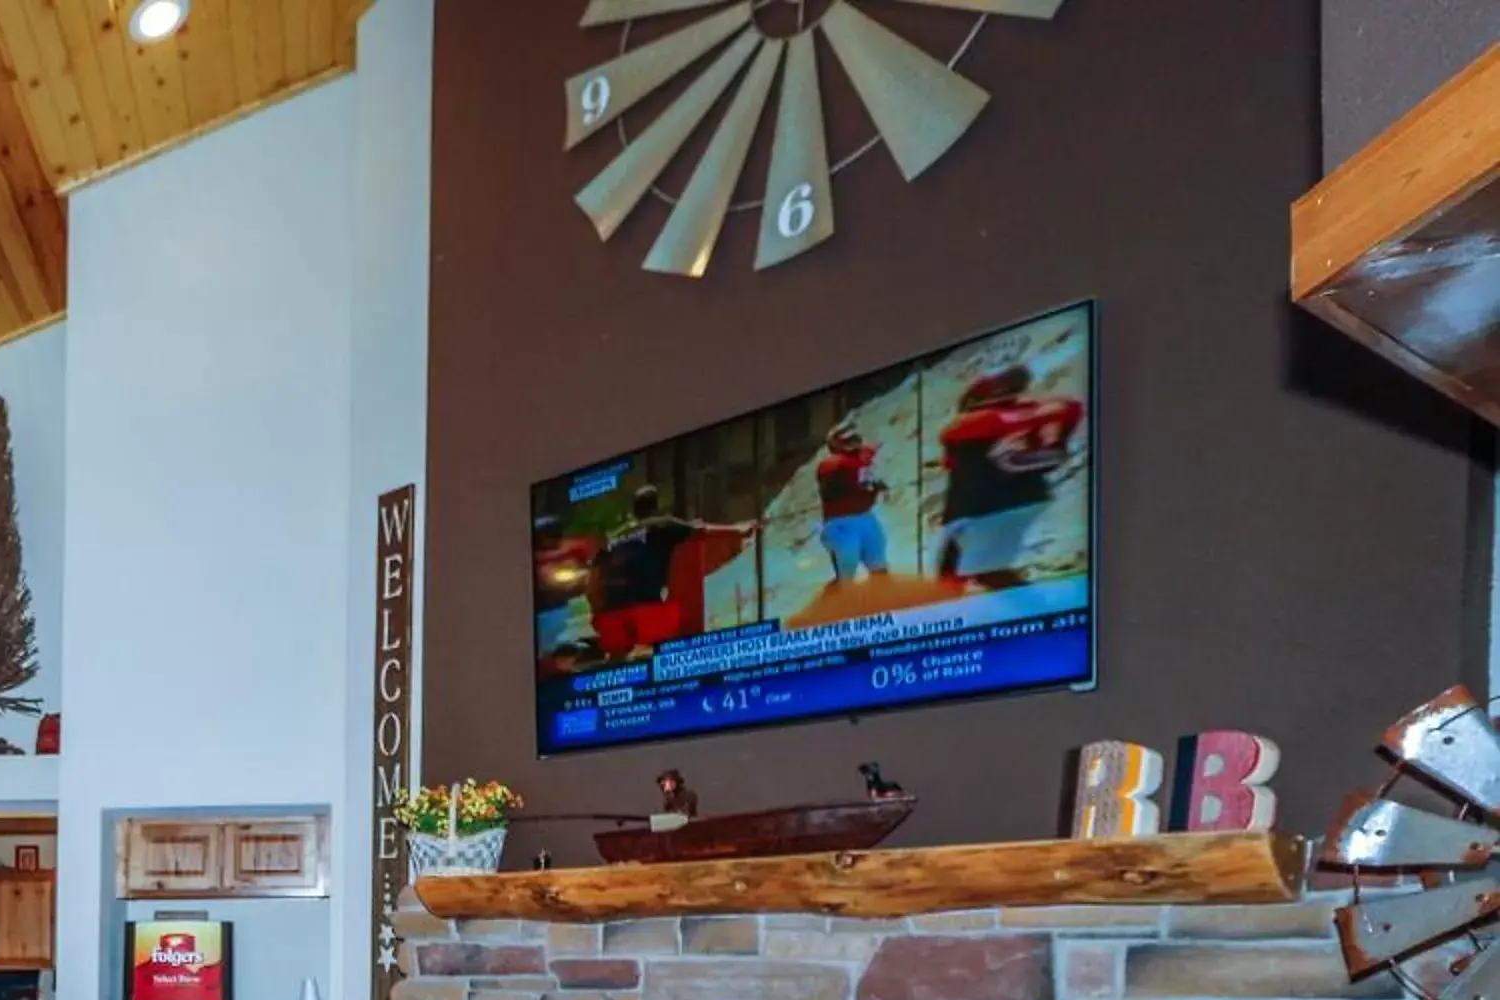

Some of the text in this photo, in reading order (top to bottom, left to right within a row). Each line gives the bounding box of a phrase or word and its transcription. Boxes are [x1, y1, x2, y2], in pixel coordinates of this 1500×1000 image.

[581, 75, 610, 126] 9
[777, 182, 814, 238] 6
[811, 620, 851, 641] AFTER
[852, 611, 895, 634] IRMA
[871, 625, 898, 645] due
[899, 622, 918, 640] to
[919, 616, 964, 636] Irma
[990, 619, 1044, 640] form
[921, 649, 984, 668] Chance
[942, 662, 983, 679] Rain
[376, 498, 410, 860] WELCOME
[871, 661, 918, 690] 0%
[1188, 729, 1281, 833] B
